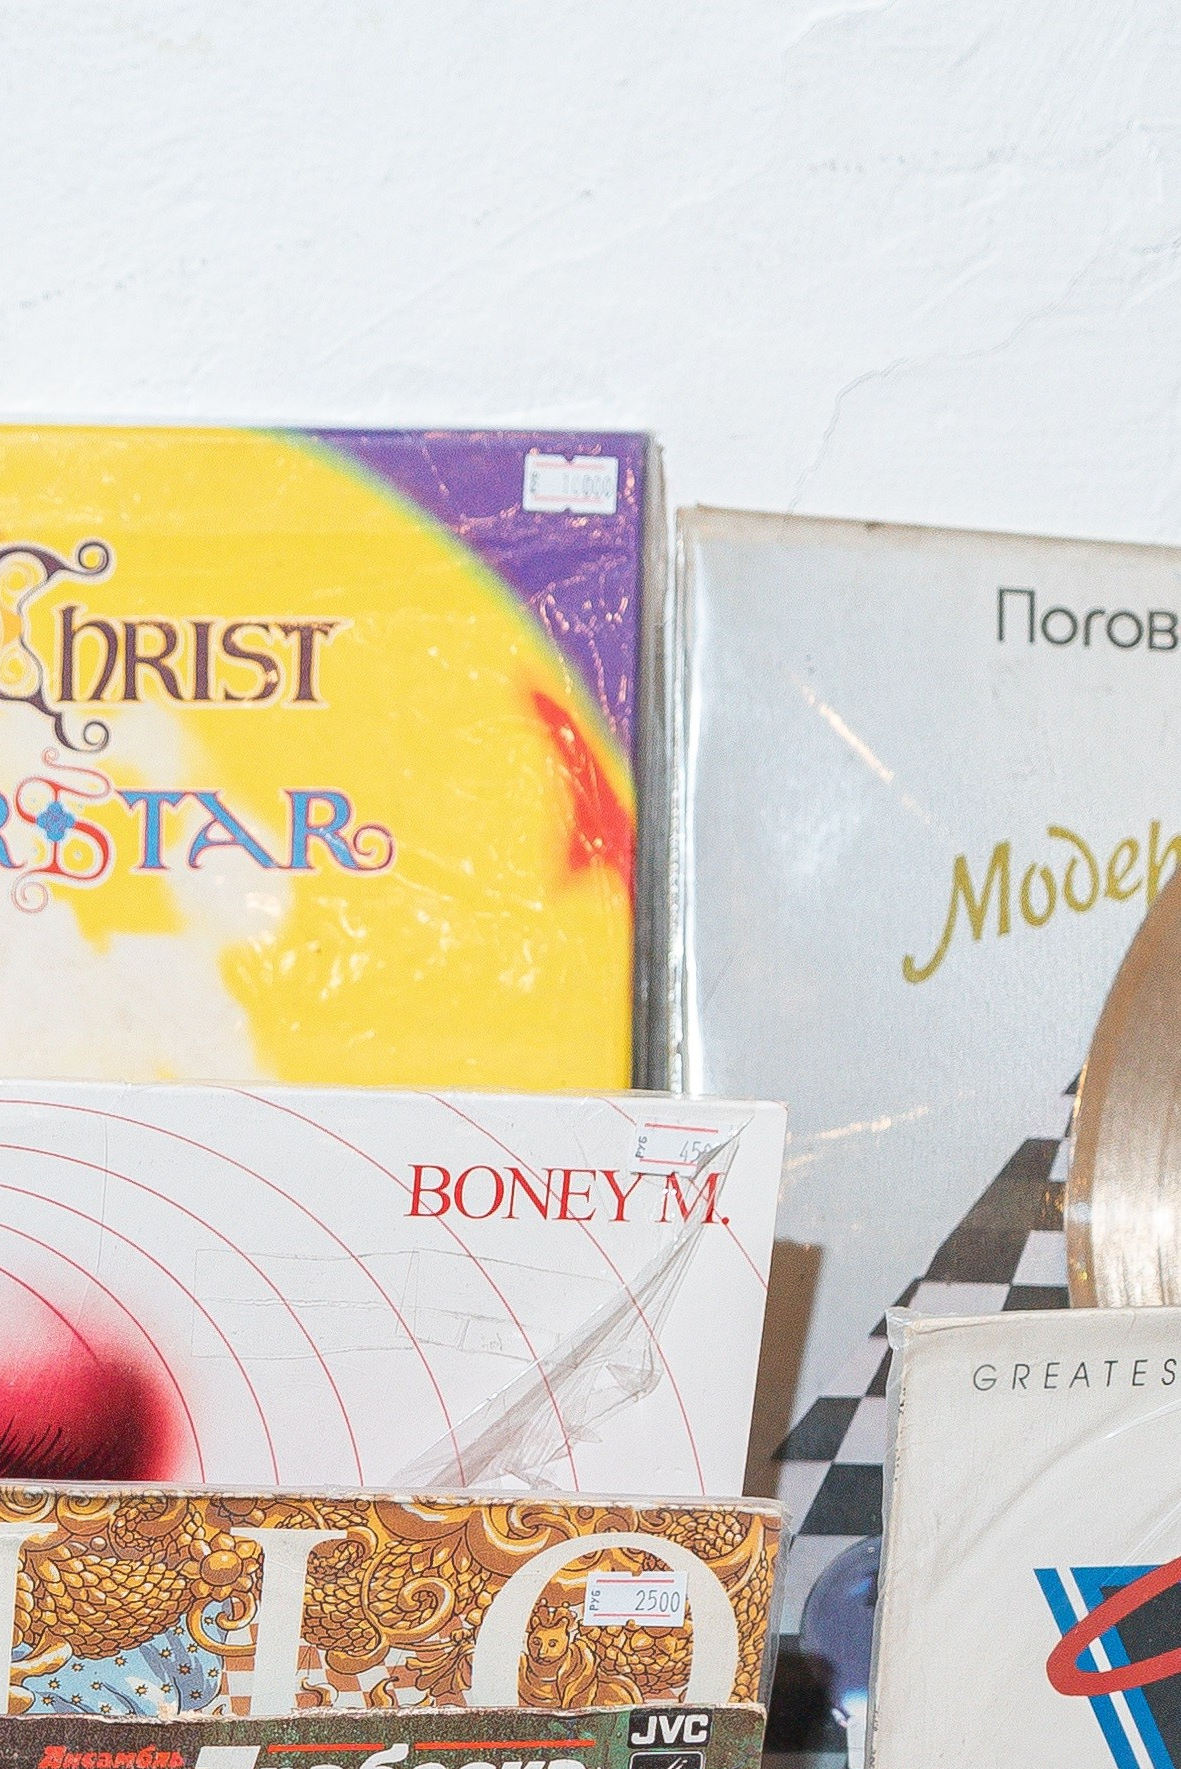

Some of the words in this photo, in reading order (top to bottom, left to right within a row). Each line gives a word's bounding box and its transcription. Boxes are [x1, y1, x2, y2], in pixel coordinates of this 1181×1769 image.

[997, 586, 1179, 650] Погов
[404, 1164, 642, 1222] BONEY
[660, 1168, 730, 1225] M.
[973, 1358, 1177, 1391] GREATES
[635, 1589, 681, 1613] 2500
[630, 1714, 709, 1745] JVC
